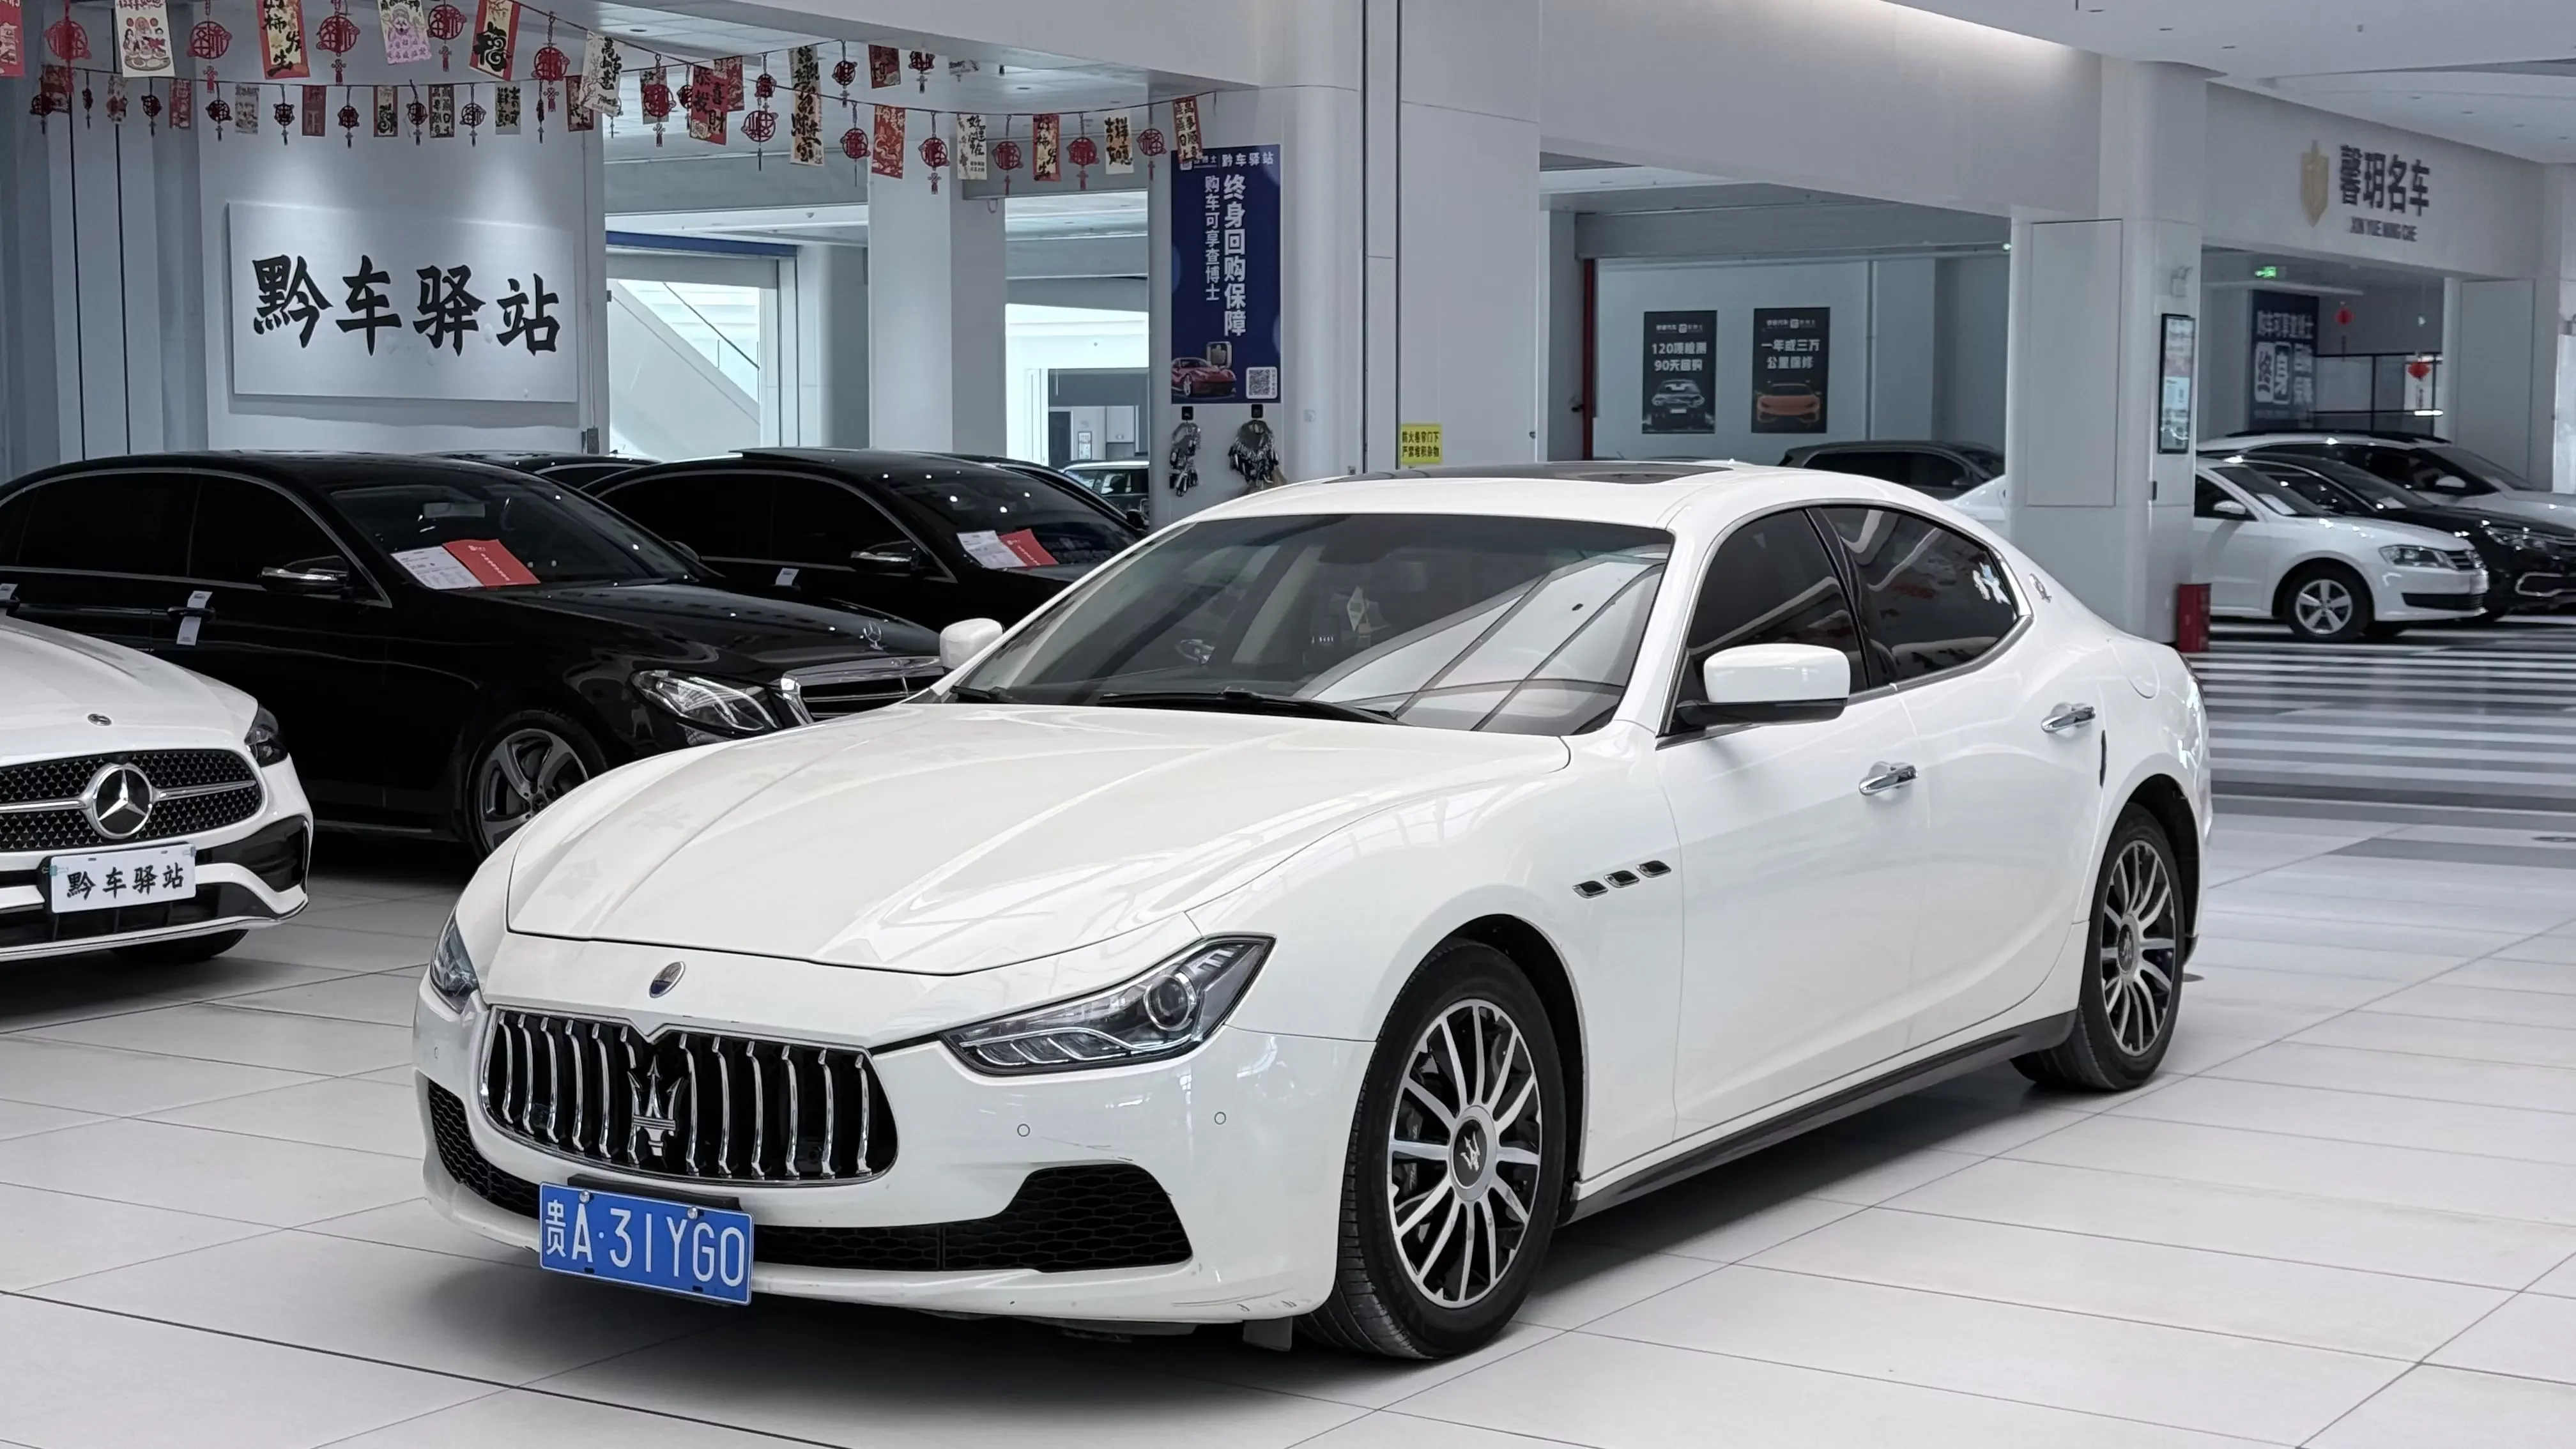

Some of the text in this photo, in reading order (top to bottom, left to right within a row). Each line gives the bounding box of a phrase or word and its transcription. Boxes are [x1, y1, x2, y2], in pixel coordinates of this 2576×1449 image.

[1222, 151, 1274, 167] 黔车驿站
[2340, 144, 2430, 217] 馨玥名车
[1204, 176, 1220, 302] 购车可享查博士
[1224, 174, 1246, 337] 终身回购保障
[252, 254, 561, 356] 黔车驿站
[1654, 358, 1703, 371] 90天回购
[1761, 339, 1820, 352] 一年或三万
[66, 862, 185, 901] 黔车驿站
